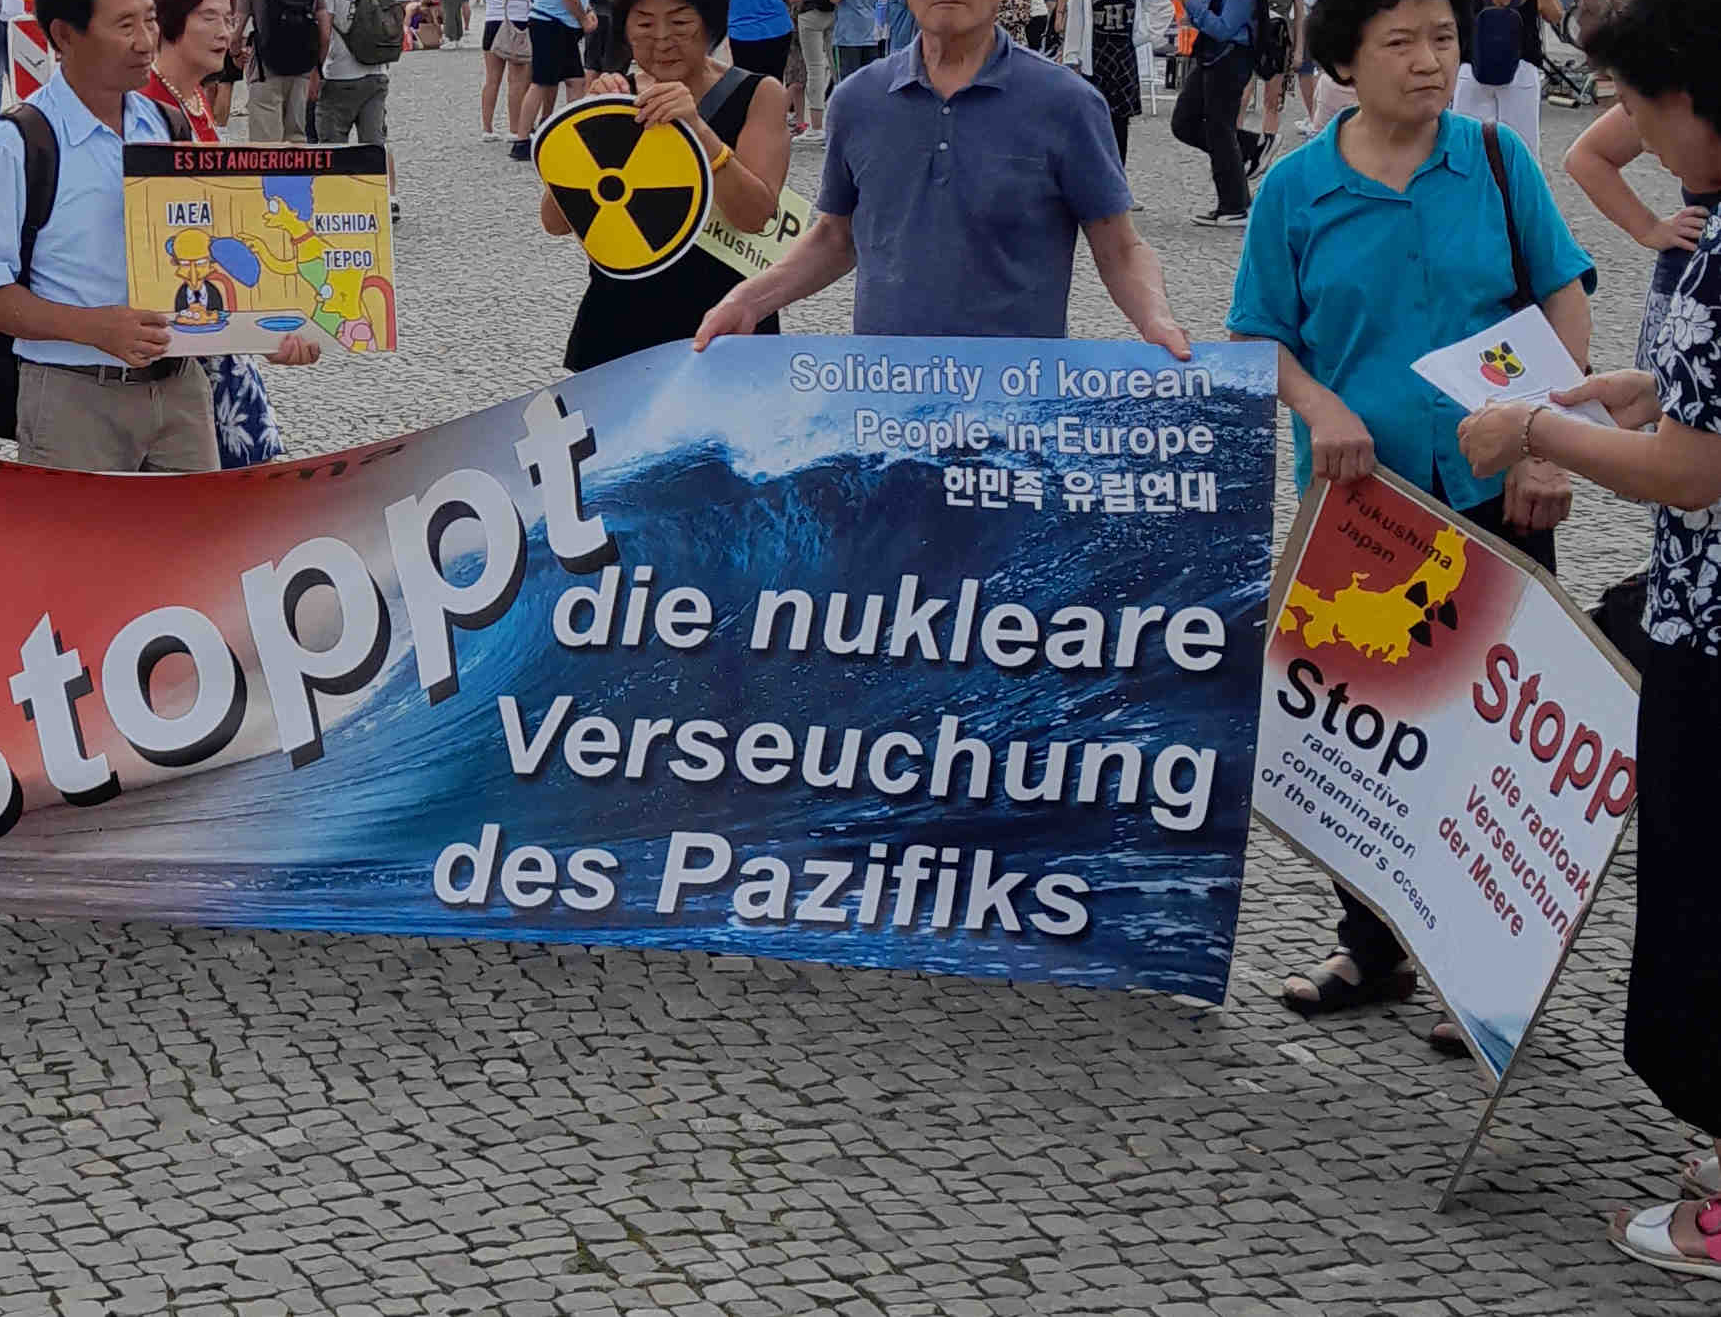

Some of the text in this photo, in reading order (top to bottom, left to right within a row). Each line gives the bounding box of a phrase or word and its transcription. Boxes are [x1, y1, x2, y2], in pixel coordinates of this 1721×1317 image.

[174, 151, 334, 170] ES IST ANGERICHTET
[166, 203, 211, 225] IAEA
[314, 213, 378, 232] KISHIDA
[324, 249, 373, 268] TEPCO
[789, 352, 1212, 401] Solidarity of korean
[854, 408, 1216, 461] People in Europe
[942, 465, 1219, 514] 한민족 유럽연대
[1337, 519, 1396, 563] Japan
[1345, 489, 1453, 571] Fukushima
[550, 564, 1227, 672] die nukleare
[1277, 656, 1428, 777] Stop
[496, 692, 1217, 832] Verseuchung
[1302, 733, 1410, 818] radioactive
[1490, 765, 1521, 808] die
[1281, 750, 1417, 860] contamination
[432, 824, 1093, 938] des Pazifiks
[1261, 768, 1438, 931] of the world's oceans
[1438, 817, 1524, 937] der Meere
